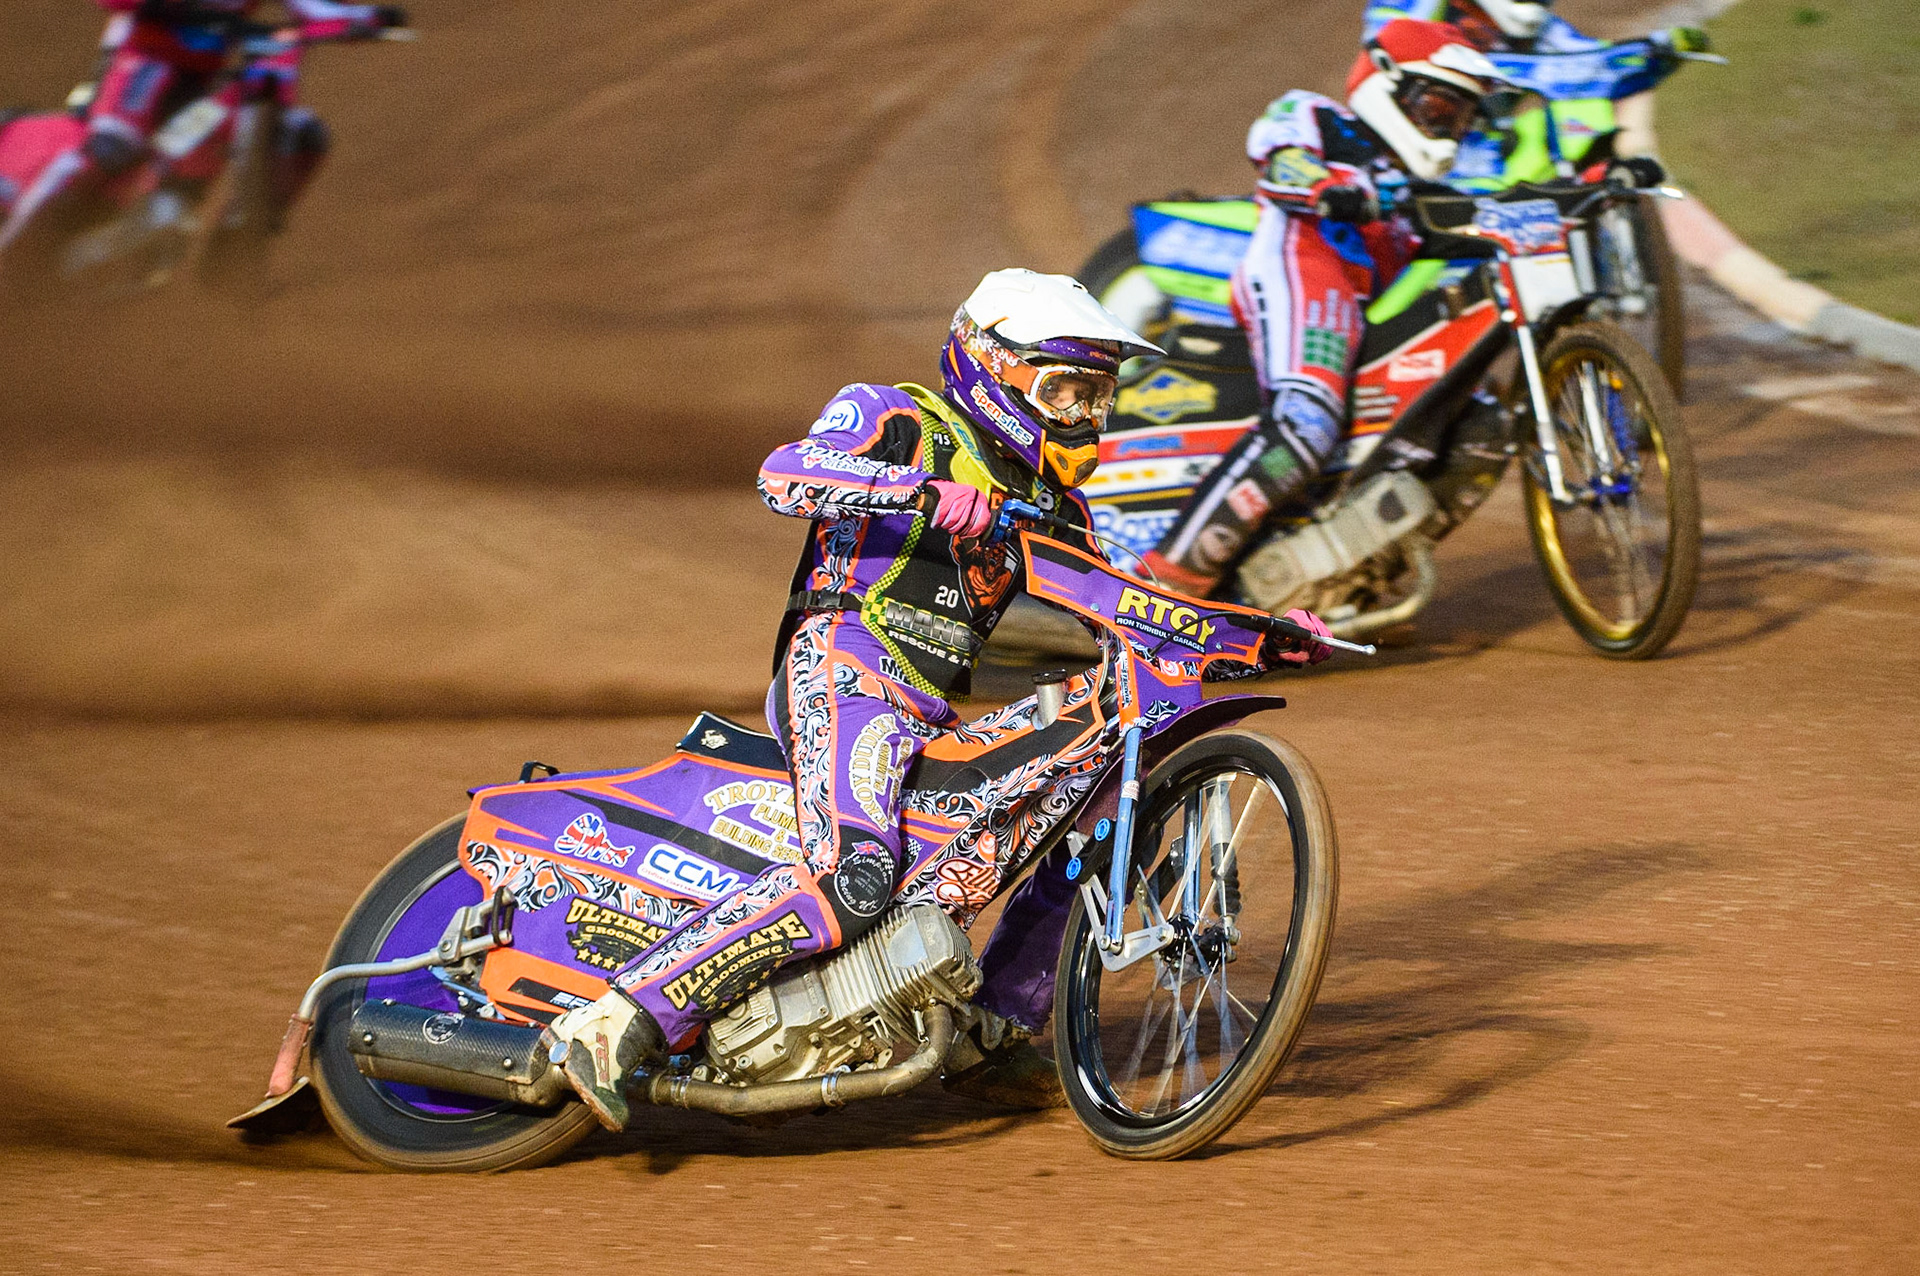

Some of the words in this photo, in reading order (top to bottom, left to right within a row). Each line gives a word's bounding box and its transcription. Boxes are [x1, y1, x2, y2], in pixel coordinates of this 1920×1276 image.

[972, 388, 1032, 442] spensites
[934, 585, 959, 608] 20
[888, 630, 947, 658] RESCUE
[948, 654, 960, 664] &
[1116, 617, 1135, 627] RON
[1172, 635, 1205, 653] GARAGES
[852, 715, 898, 771] DUDLEY
[708, 783, 787, 811] TROY
[714, 819, 772, 853] BUILDING
[775, 829, 785, 843] &
[650, 849, 732, 893] CCM
[663, 912, 811, 1010] ULTIMATE
[701, 945, 784, 997] GROOMING
